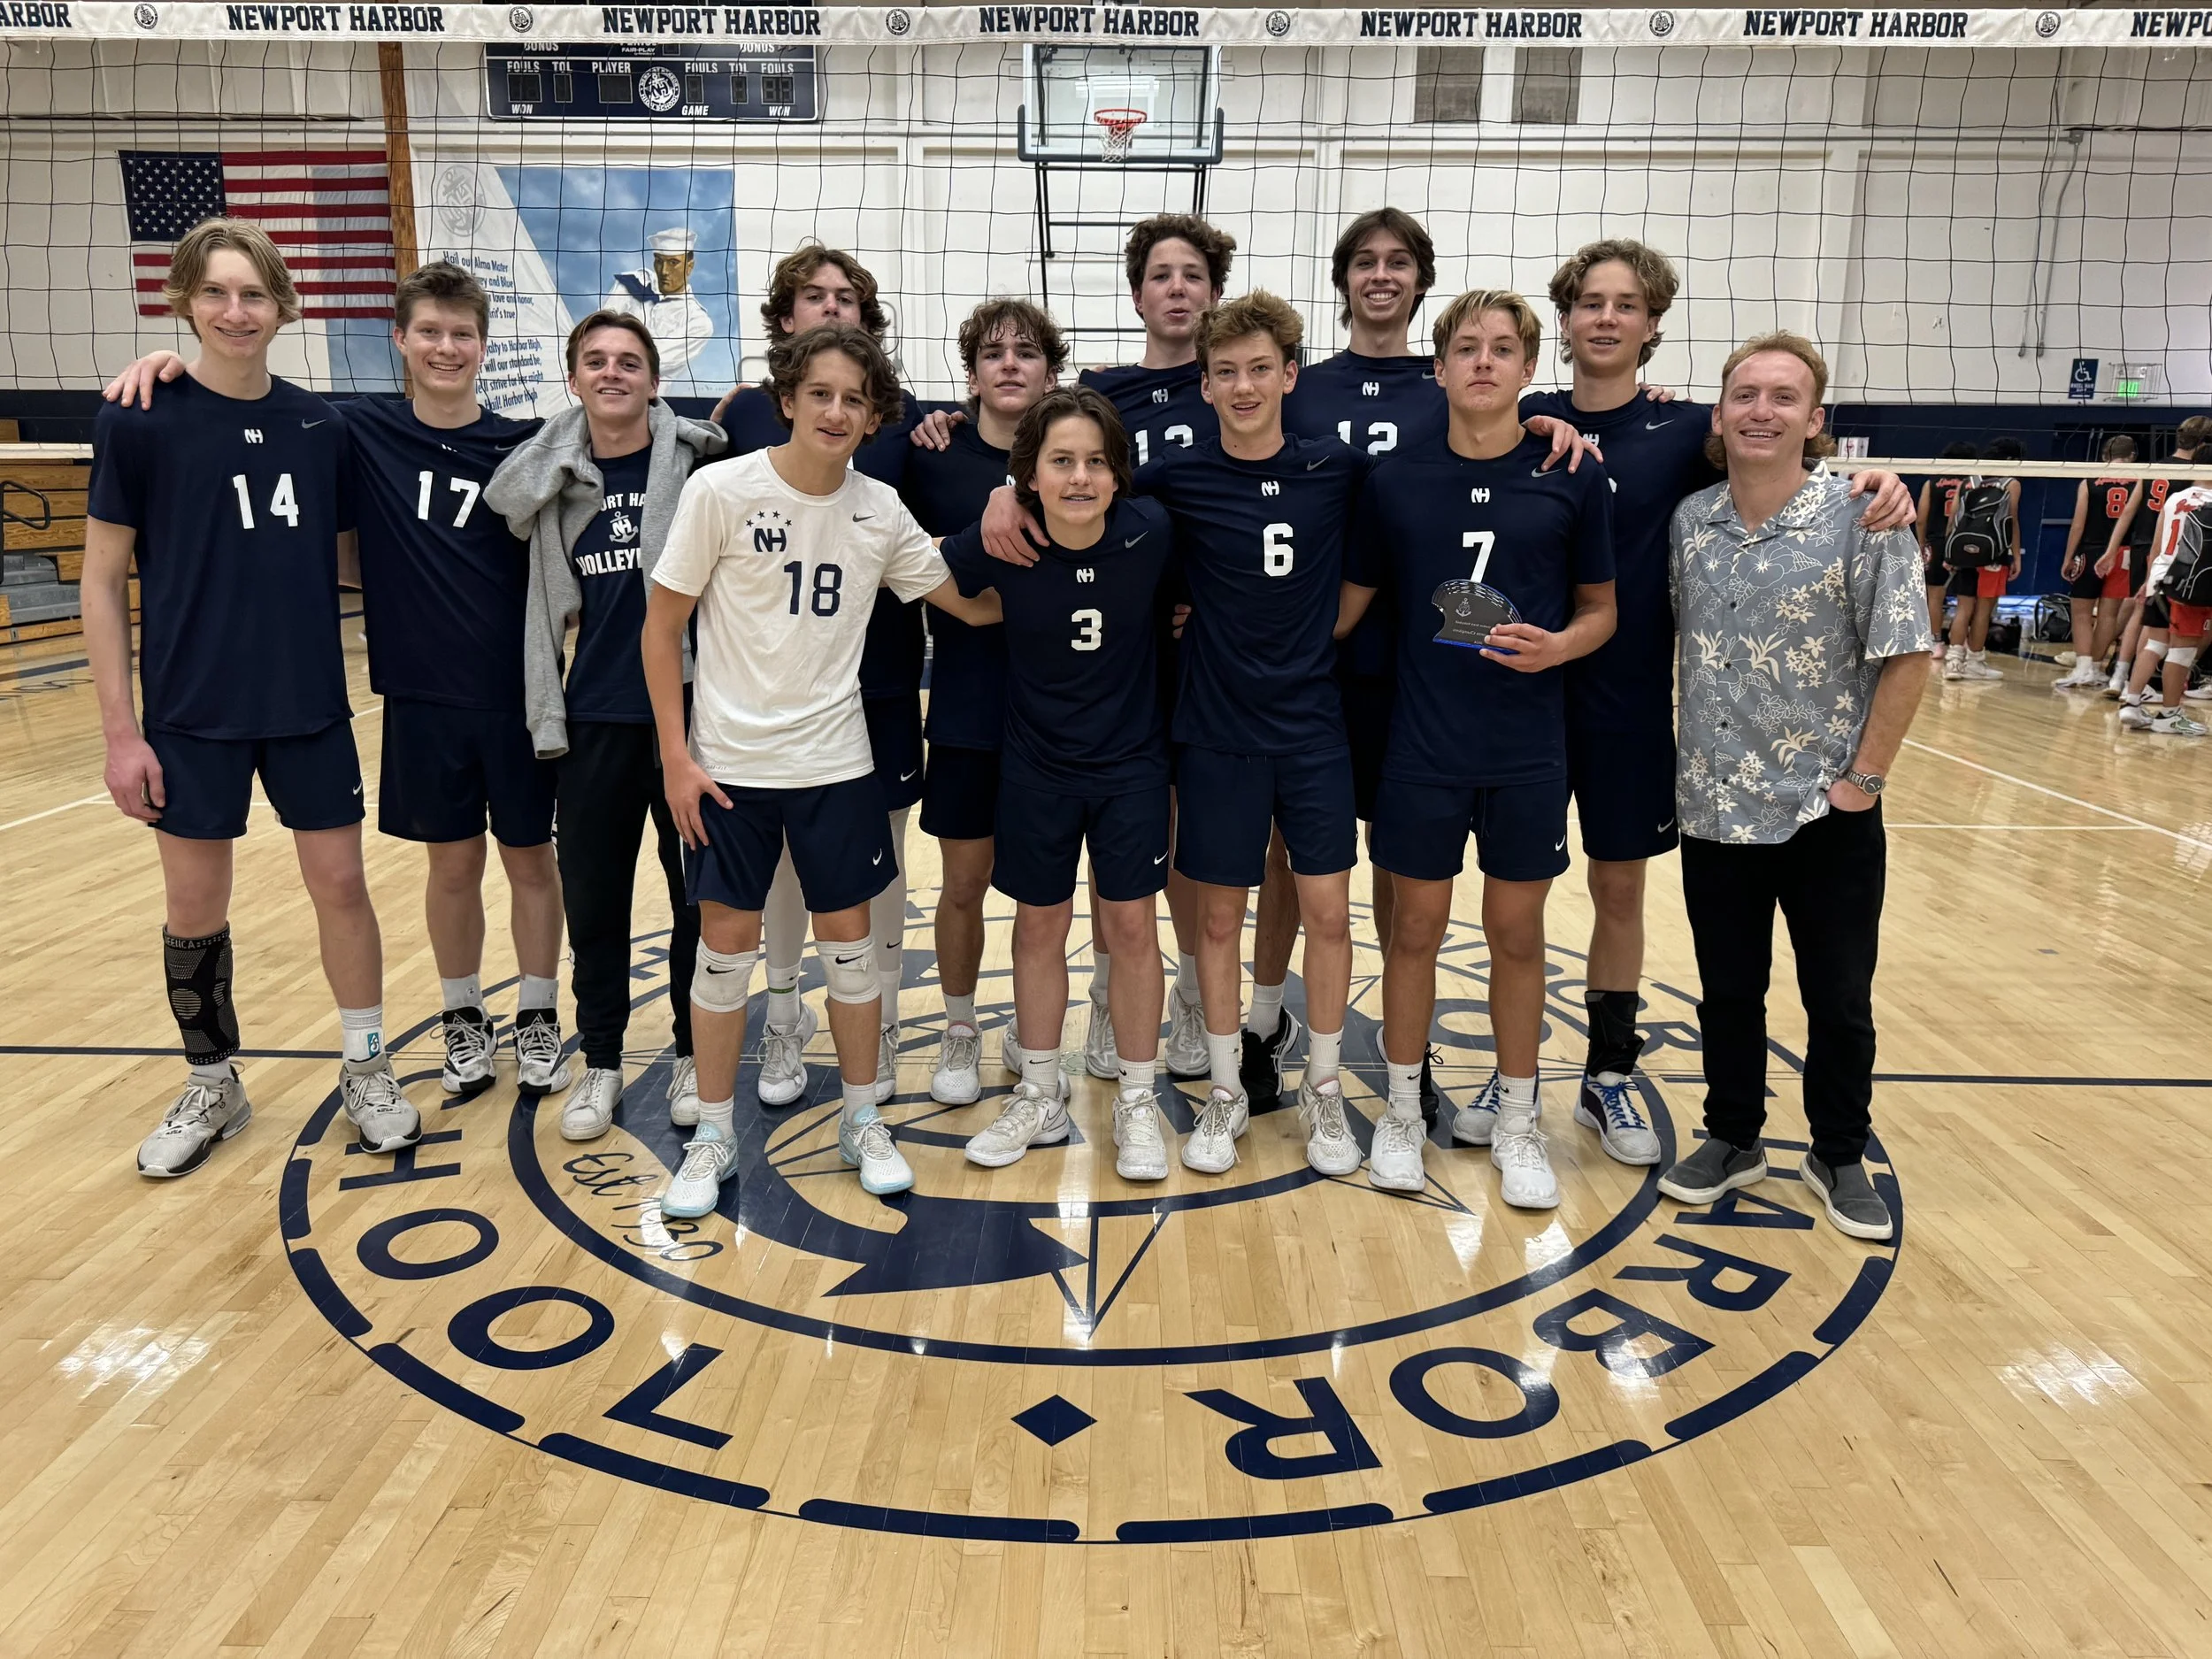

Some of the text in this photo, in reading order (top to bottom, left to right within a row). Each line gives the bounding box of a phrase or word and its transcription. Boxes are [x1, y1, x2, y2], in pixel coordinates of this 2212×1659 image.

[227, 5, 445, 32] NEWPORT HARBOR
[602, 7, 821, 35] NEWPORT HARBOR
[979, 6, 1199, 36] NEWPORT HARBOR
[1360, 11, 1582, 38] NEWPORT HARBOR
[1743, 10, 1968, 38] NEWPORT HARBOR
[507, 61, 540, 73] FOULS
[552, 61, 572, 73] TOL
[592, 62, 632, 73] PLAYER
[685, 62, 718, 73] FOULS
[761, 63, 794, 75] FOULS
[511, 104, 534, 115] WON
[681, 105, 709, 117] GAME
[769, 105, 791, 117] WON
[443, 250, 509, 273] Hail ou Alma Mater
[488, 274, 500, 287] and
[500, 275, 514, 288] Blue
[491, 293, 505, 303] love
[503, 309, 516, 319] true
[502, 342, 508, 353] to
[484, 358, 497, 373] will
[497, 361, 508, 371] our
[489, 378, 508, 391] strive
[1363, 381, 1379, 396] NH
[503, 391, 524, 408] Harbor
[1152, 388, 1169, 403] NH
[244, 428, 264, 443] NH
[1261, 480, 1280, 496] NH
[1471, 488, 1491, 503] NH
[2147, 479, 2170, 511] 9
[233, 473, 299, 529] 14
[418, 470, 480, 528] 17
[2106, 487, 2129, 518] 8
[754, 527, 787, 552] NH
[1263, 522, 1294, 577] 6
[1462, 531, 1495, 583] 7
[1076, 568, 1094, 583] NH
[784, 560, 842, 617] 18
[1071, 609, 1102, 651] 3
